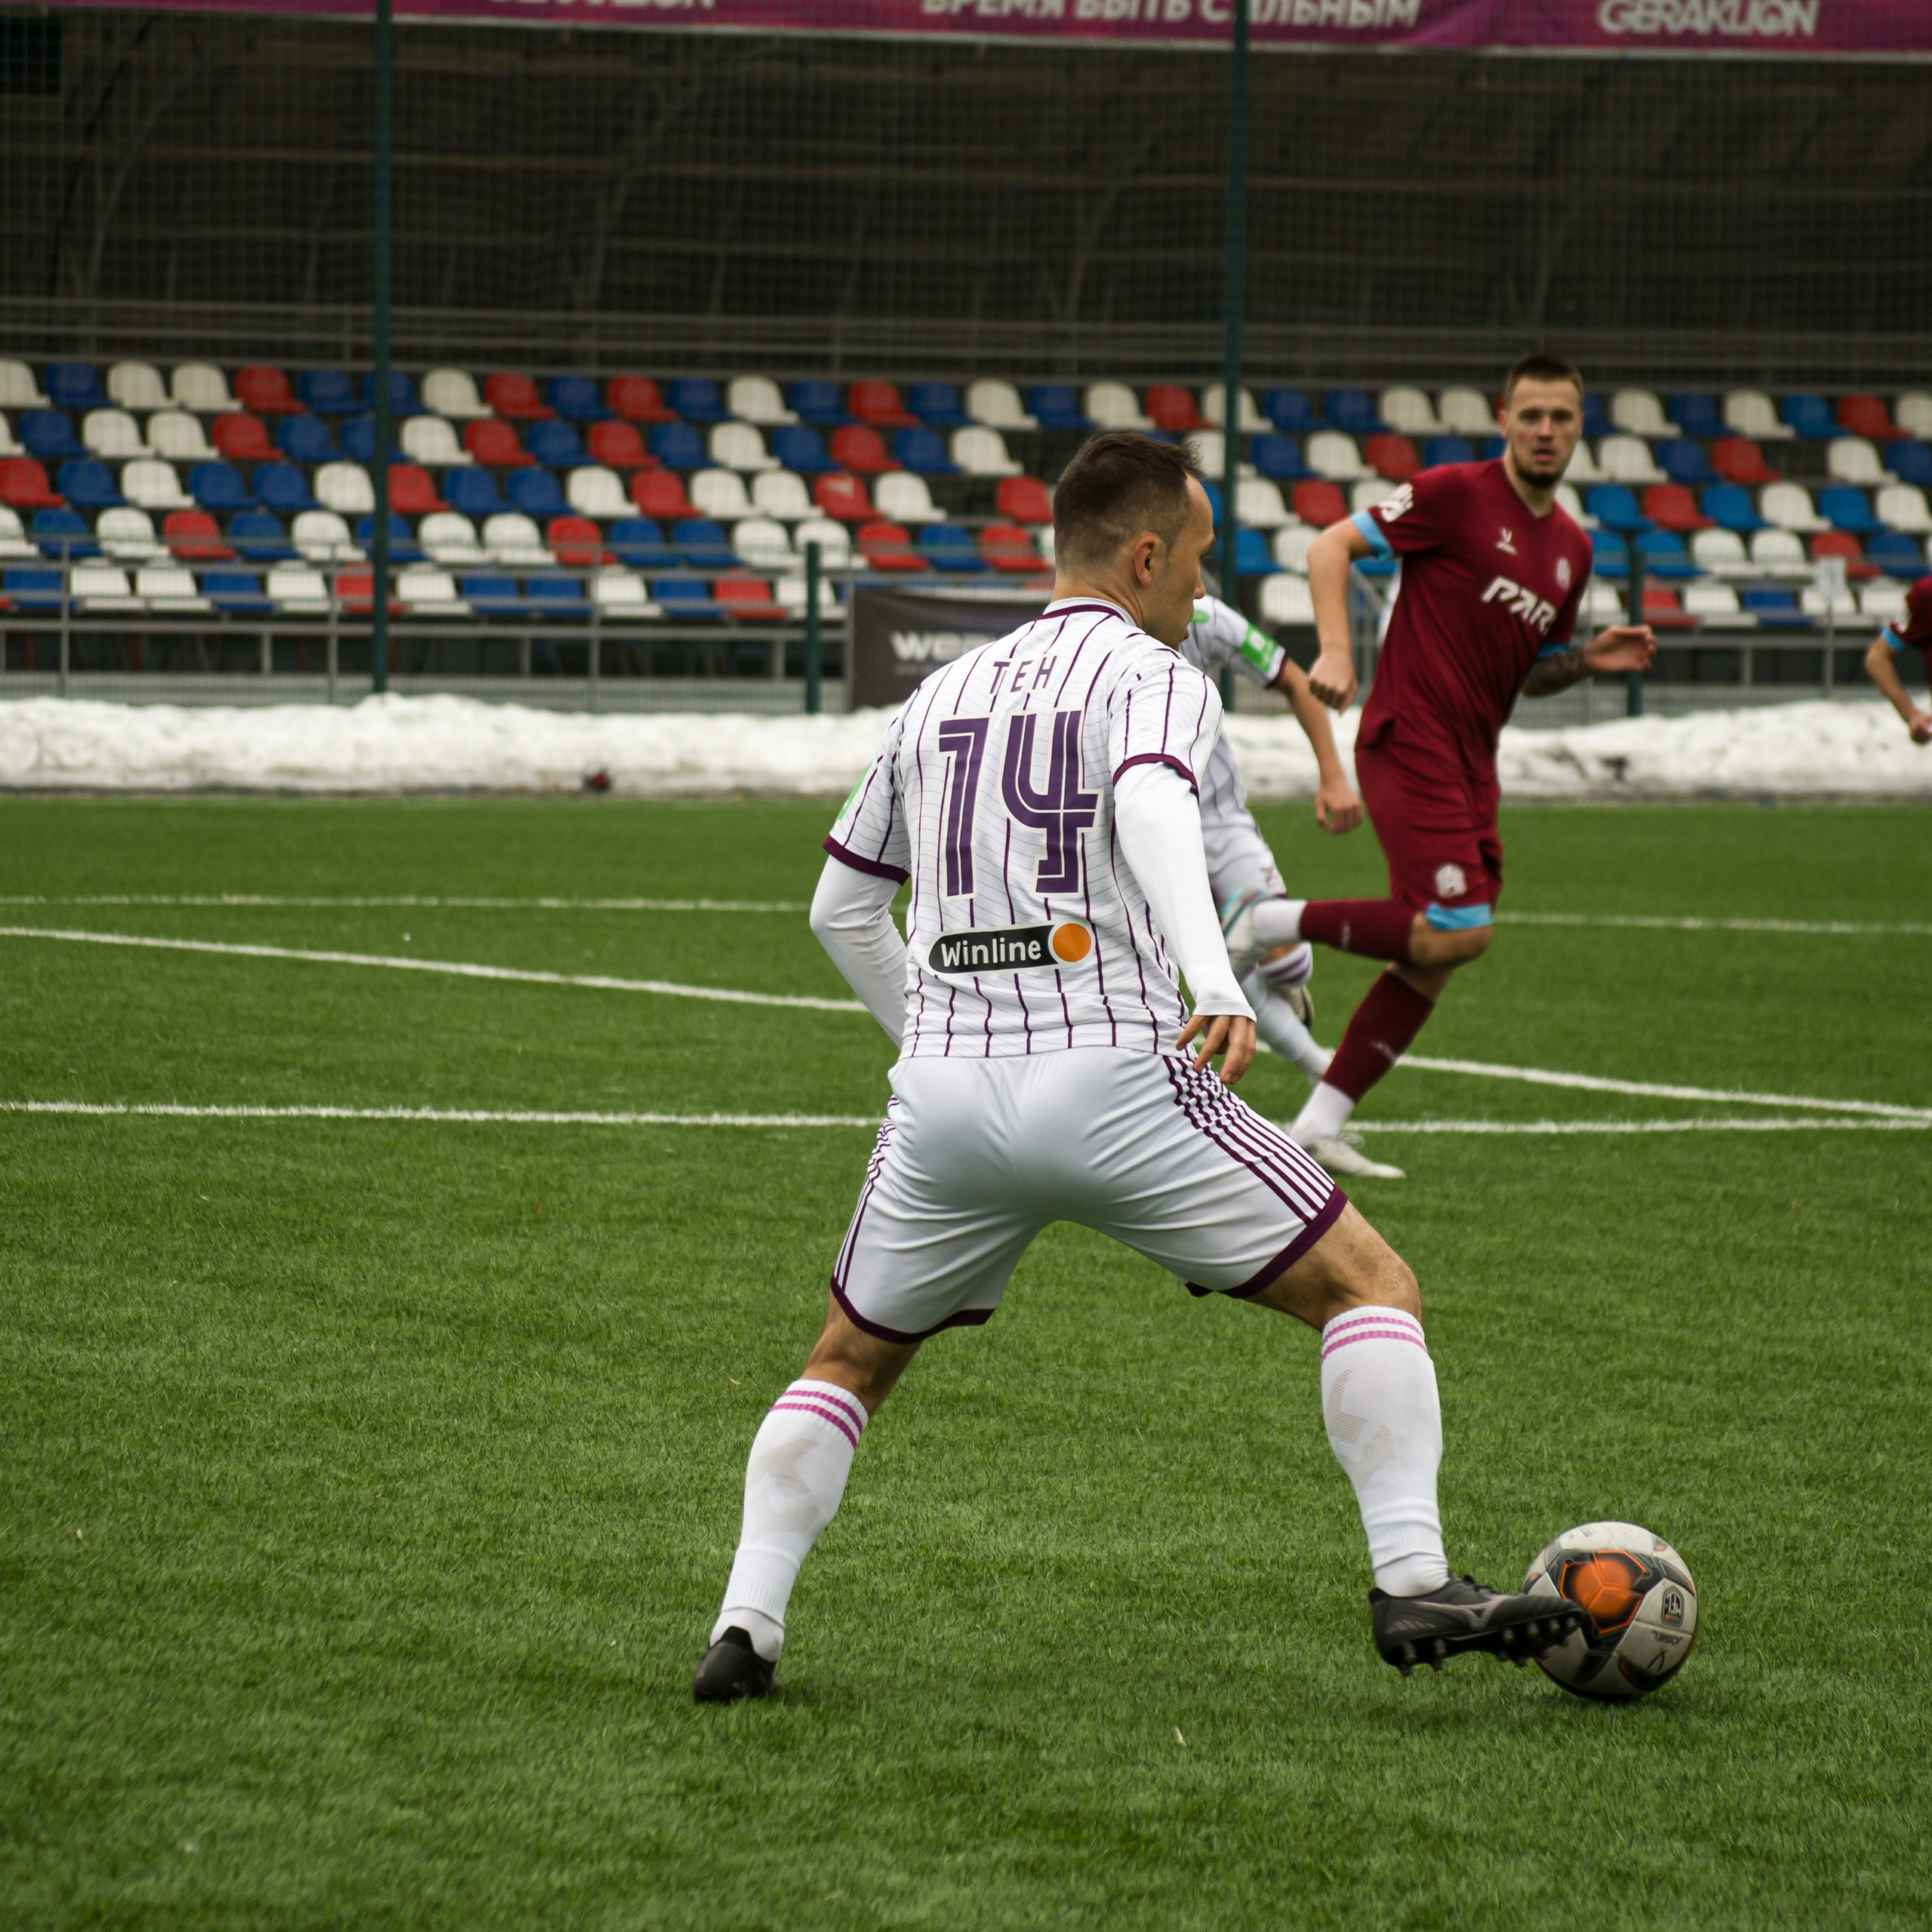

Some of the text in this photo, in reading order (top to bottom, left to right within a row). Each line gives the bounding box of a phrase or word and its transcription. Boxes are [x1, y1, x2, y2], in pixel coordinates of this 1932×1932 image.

[1481, 576, 1557, 635] PAR
[937, 708, 1101, 899] 14
[940, 937, 1042, 968] Winline
